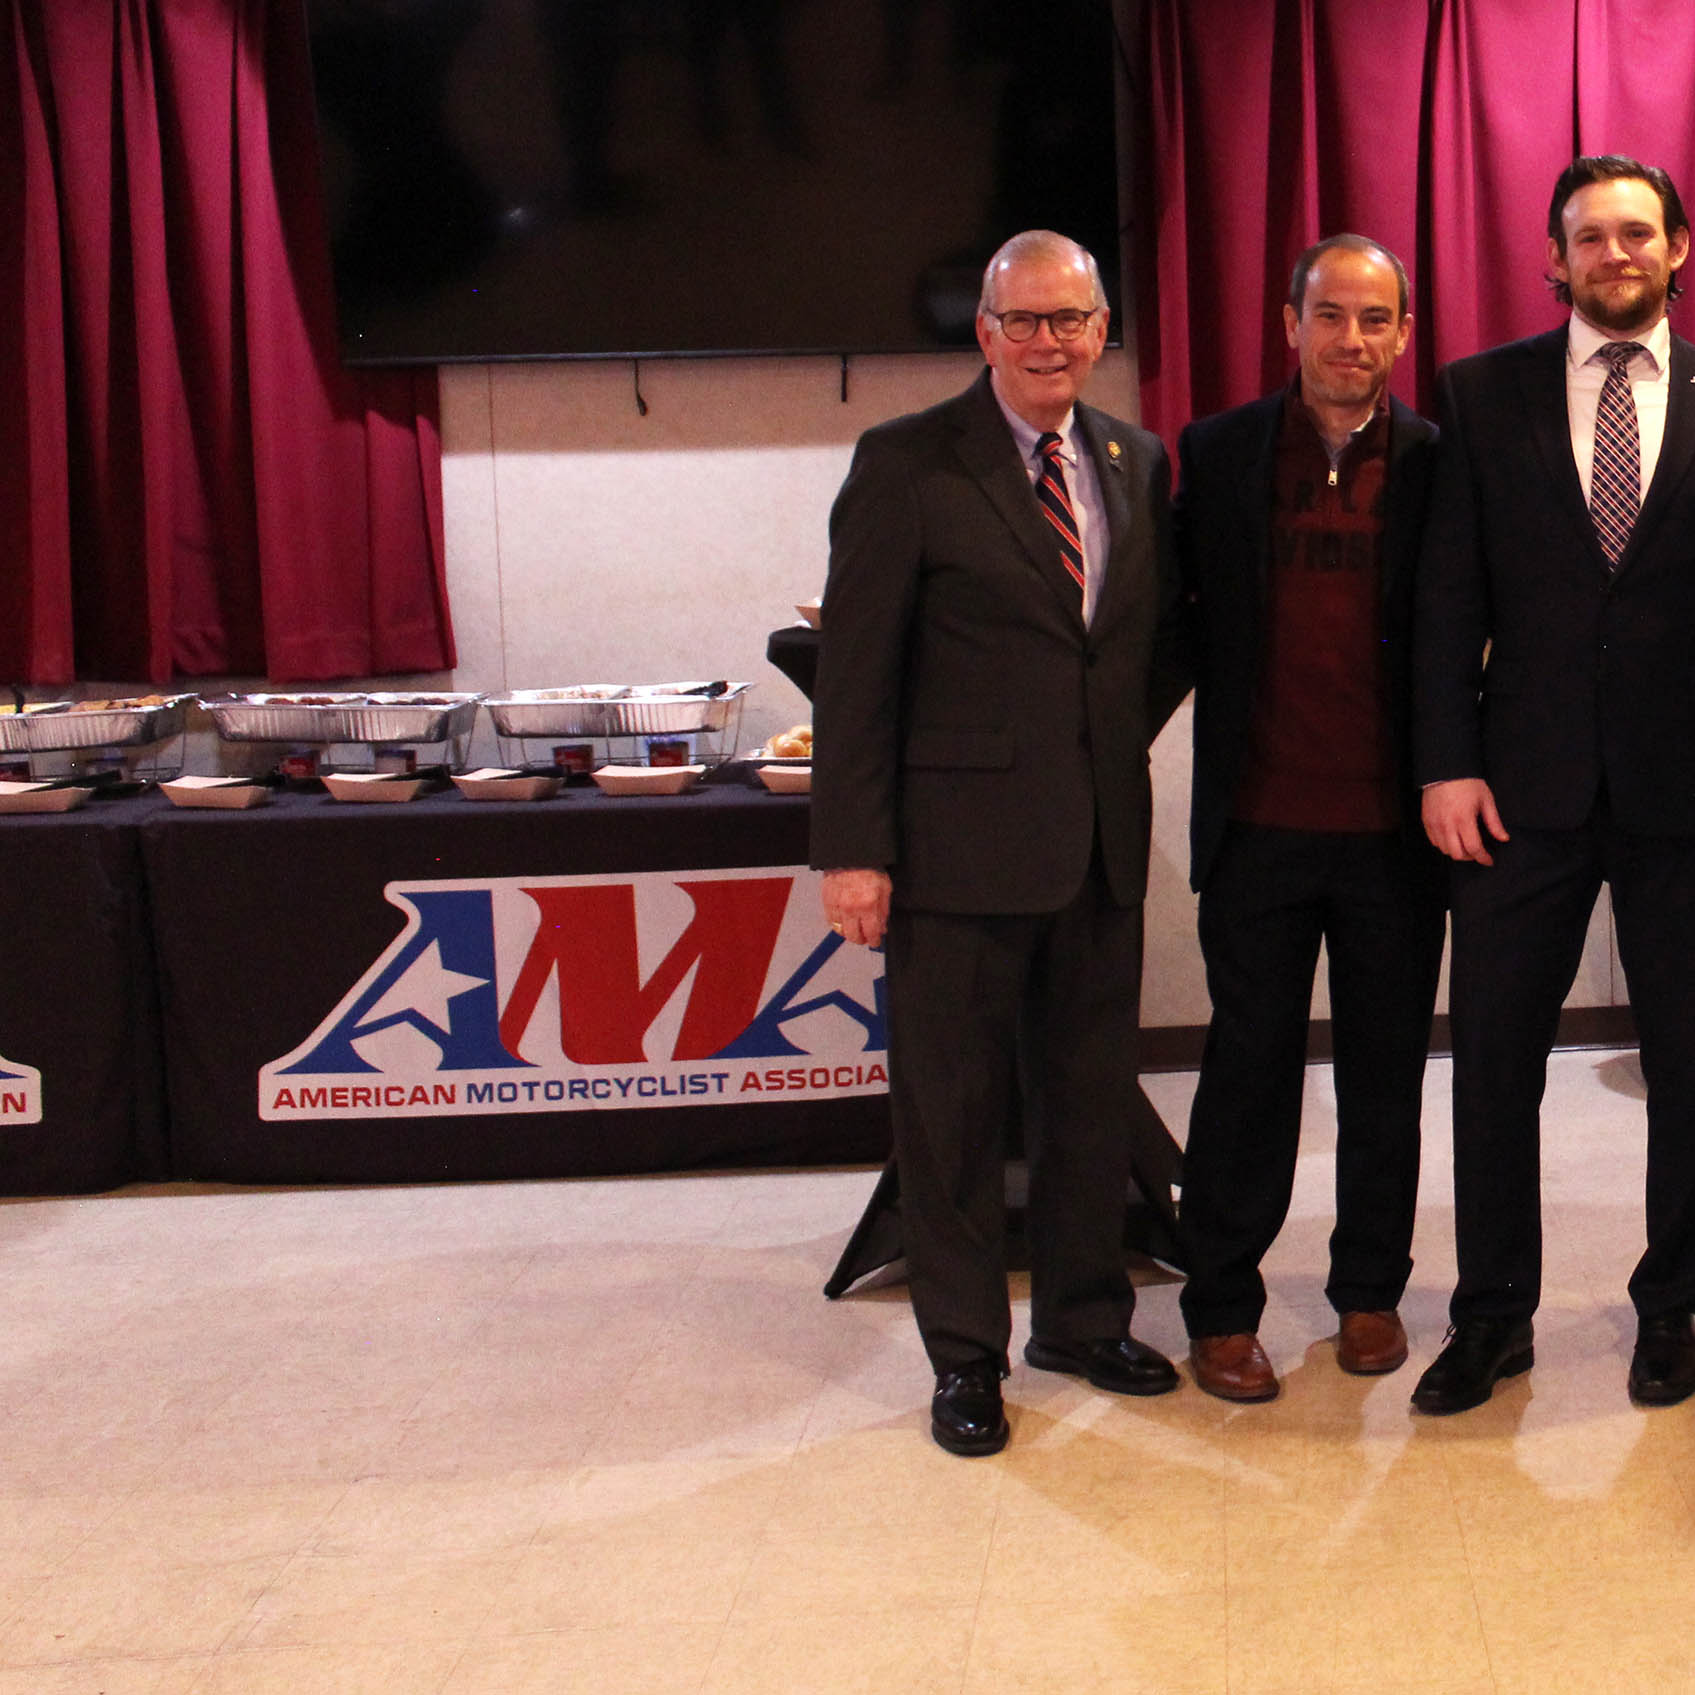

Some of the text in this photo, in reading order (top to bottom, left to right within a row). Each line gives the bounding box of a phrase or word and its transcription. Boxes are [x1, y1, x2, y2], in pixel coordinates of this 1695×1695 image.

[273, 1065, 890, 1110] AMERICAN MOTORCYCLIST ASSOCIA
